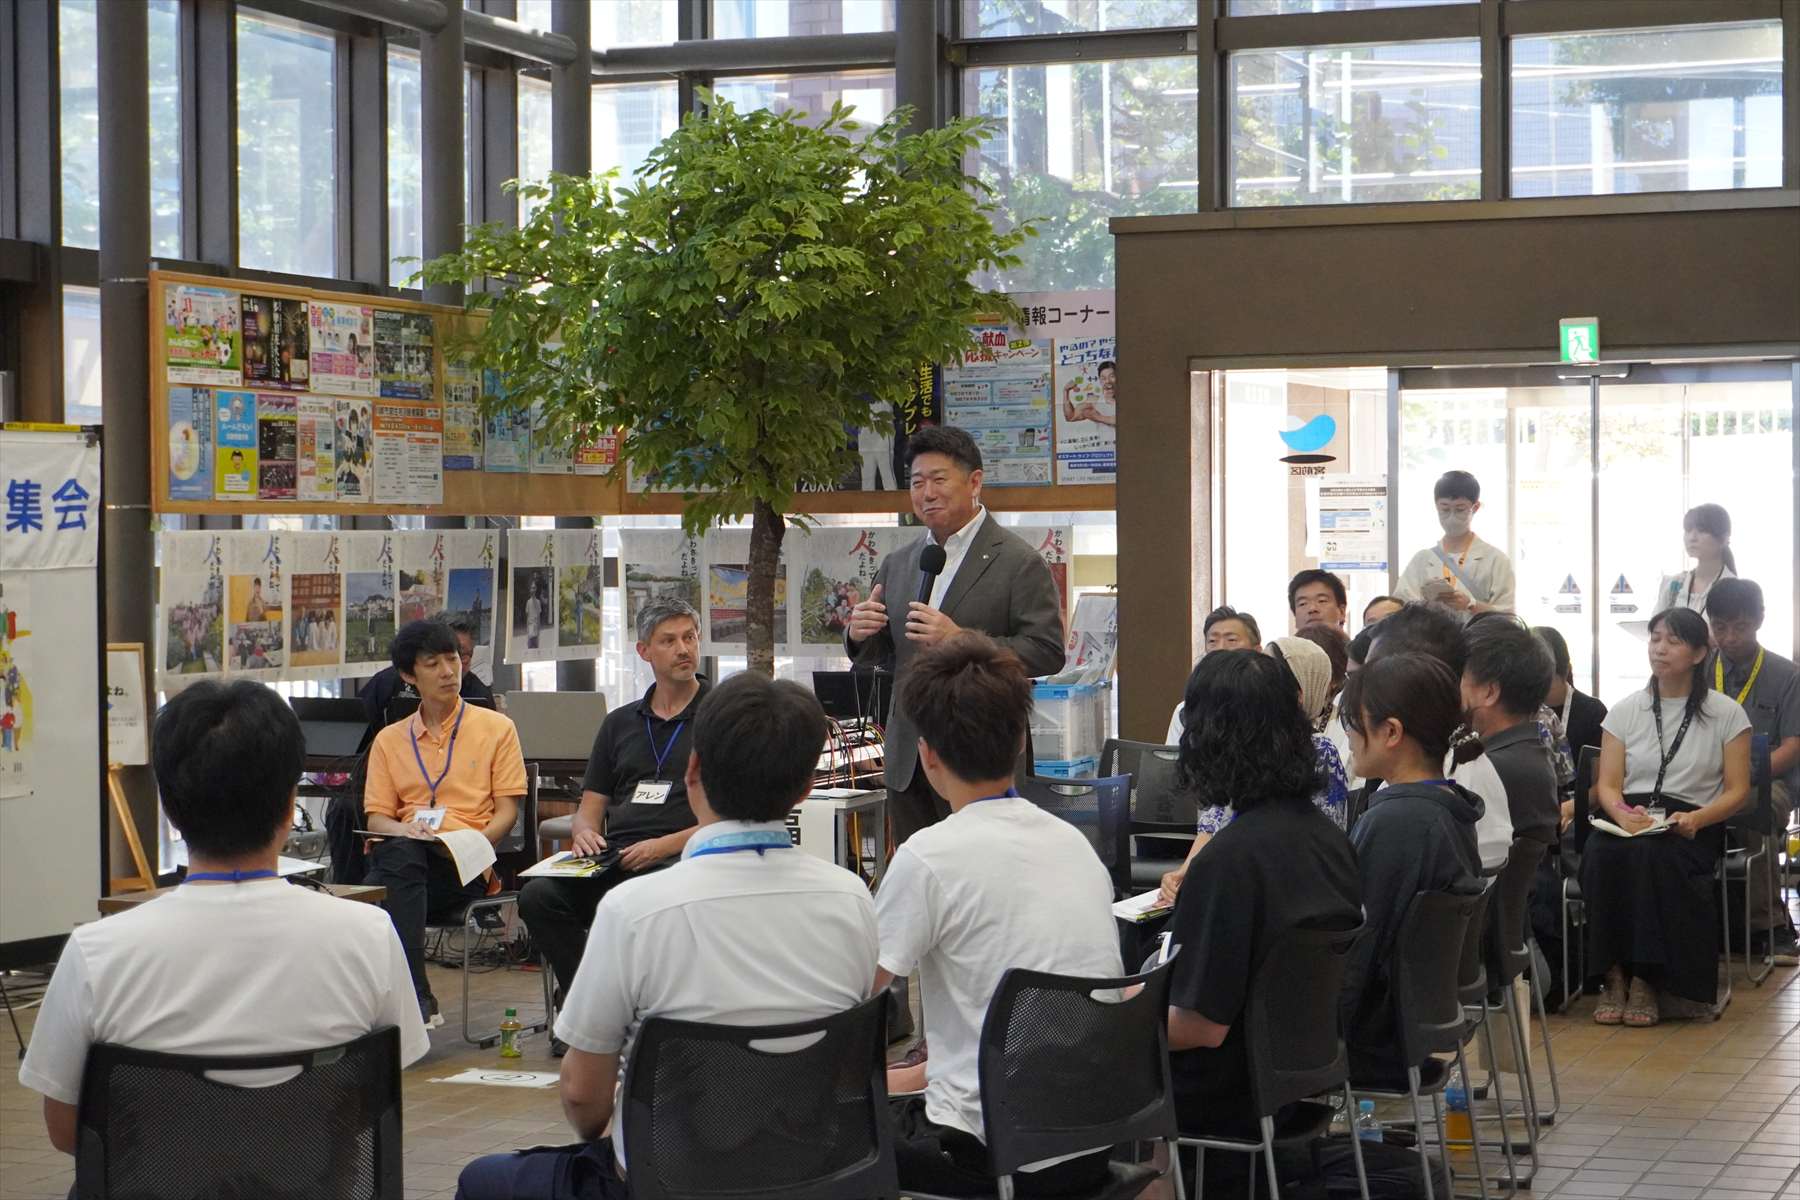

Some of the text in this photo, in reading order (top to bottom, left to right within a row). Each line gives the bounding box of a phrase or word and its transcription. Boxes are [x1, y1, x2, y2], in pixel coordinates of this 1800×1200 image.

[1061, 348, 1116, 366] どっちな
[6, 478, 90, 534] 集会
